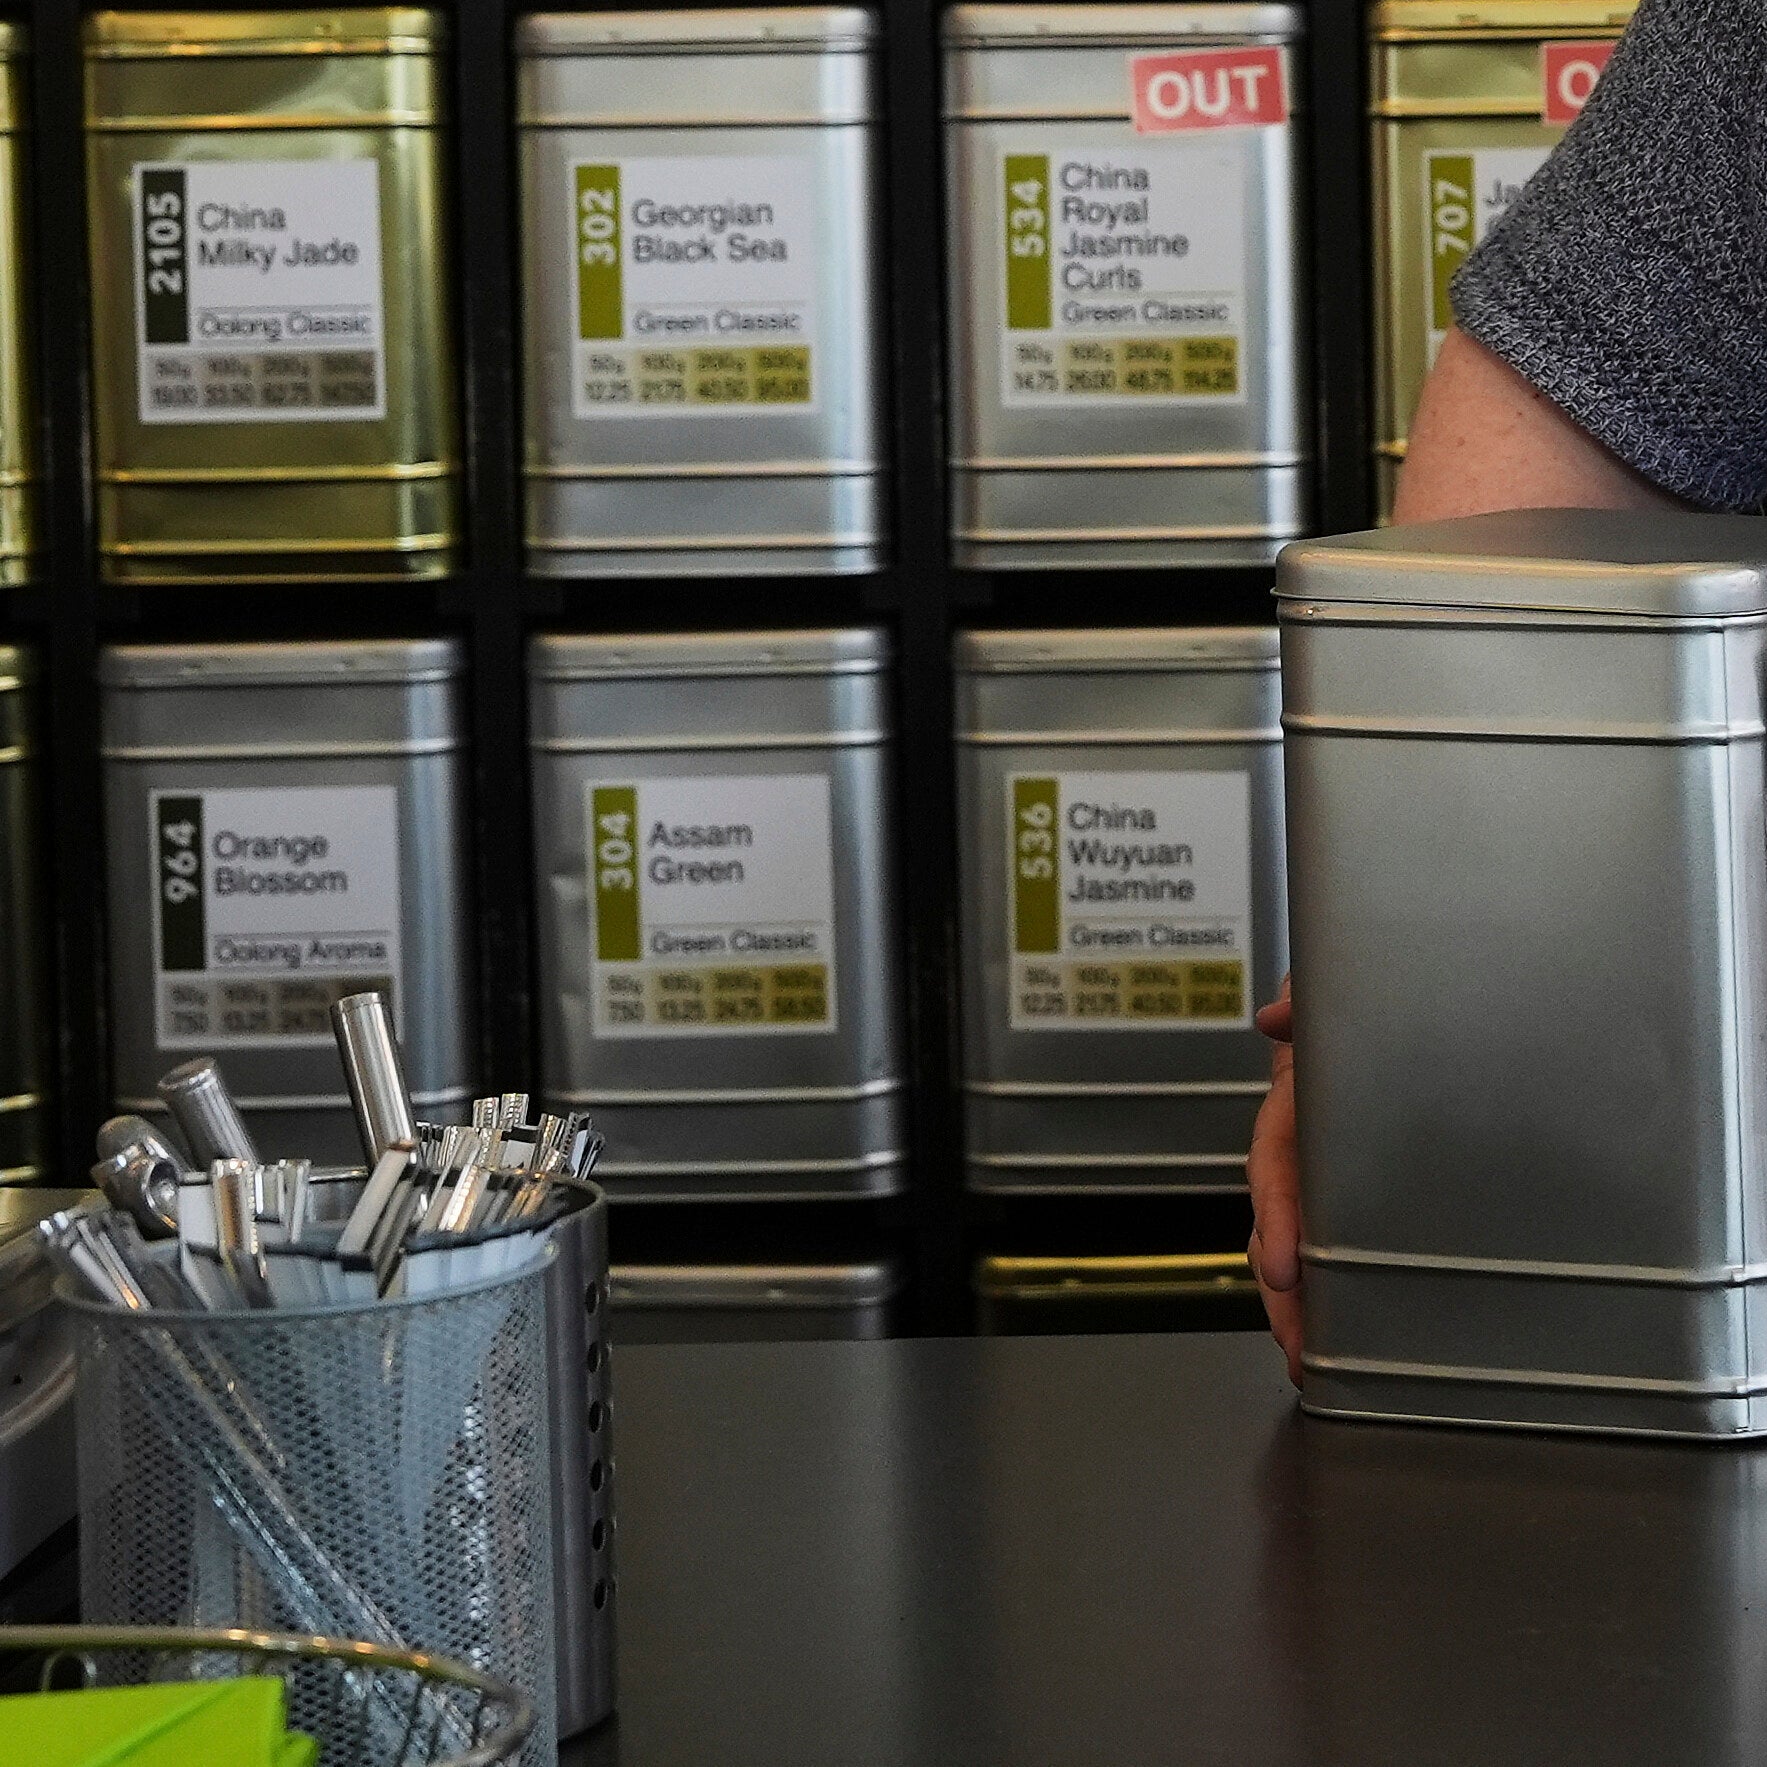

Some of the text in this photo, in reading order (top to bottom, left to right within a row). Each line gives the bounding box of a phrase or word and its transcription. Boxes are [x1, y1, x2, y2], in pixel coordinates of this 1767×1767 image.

[1147, 64, 1269, 120] OUT
[1059, 162, 1151, 193] China
[196, 203, 287, 234] China
[631, 198, 773, 235] Georgian
[1011, 180, 1047, 257] 534
[1060, 195, 1148, 231] Royal
[1436, 180, 1470, 255] 707
[148, 192, 182, 294] 2105
[197, 238, 360, 273] Milky Jade
[632, 233, 788, 264] Black Sea
[1061, 231, 1190, 259] Jasmine
[1060, 261, 1142, 294] Curls
[1066, 801, 1157, 833] China
[211, 830, 330, 867] Orange
[600, 809, 634, 890] 304
[647, 820, 753, 850] Assam
[648, 855, 745, 886] Green
[1068, 839, 1193, 874] Wuyuan
[211, 866, 348, 897] Blossom
[1067, 875, 1196, 903] Jasmine
[1069, 924, 1234, 952] Green Classic
